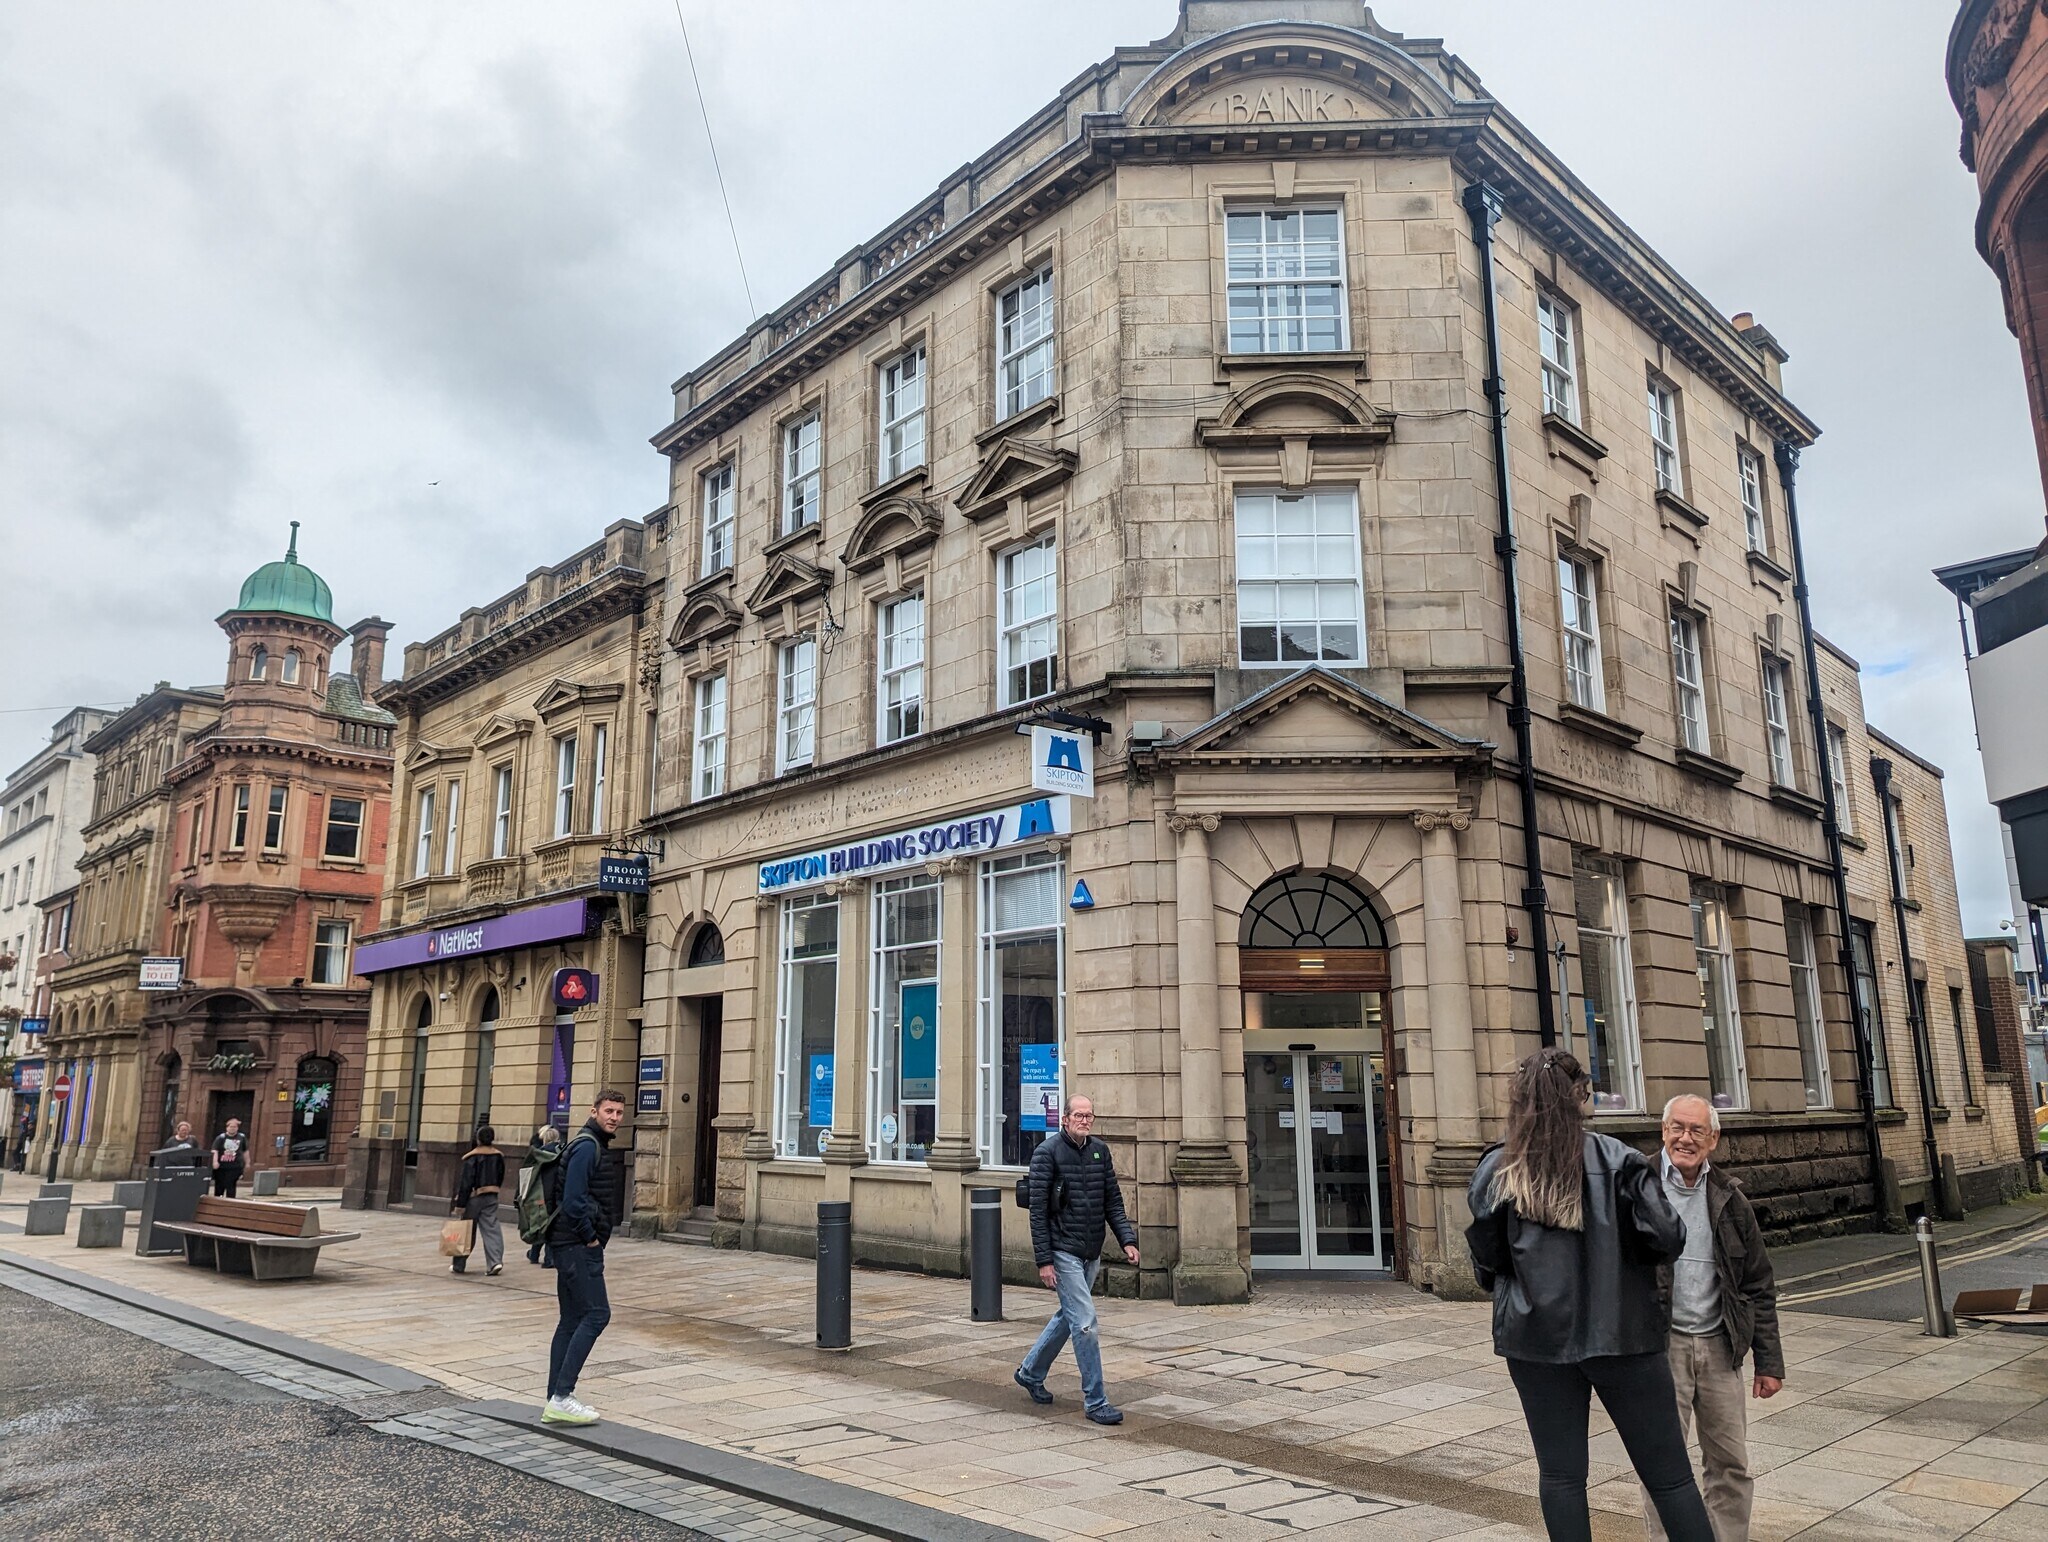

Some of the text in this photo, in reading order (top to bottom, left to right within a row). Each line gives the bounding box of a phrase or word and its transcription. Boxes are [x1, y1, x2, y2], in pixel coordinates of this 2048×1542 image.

[1225, 87, 1335, 123] BANK
[1046, 767, 1084, 783] SKIPTON
[1046, 779, 1066, 787] BUILDING
[759, 814, 1005, 889] SKIPTON BUILDING SOCIETY
[607, 865, 643, 876] BROOK
[602, 875, 646, 886] STREET
[439, 926, 483, 955] NatWest
